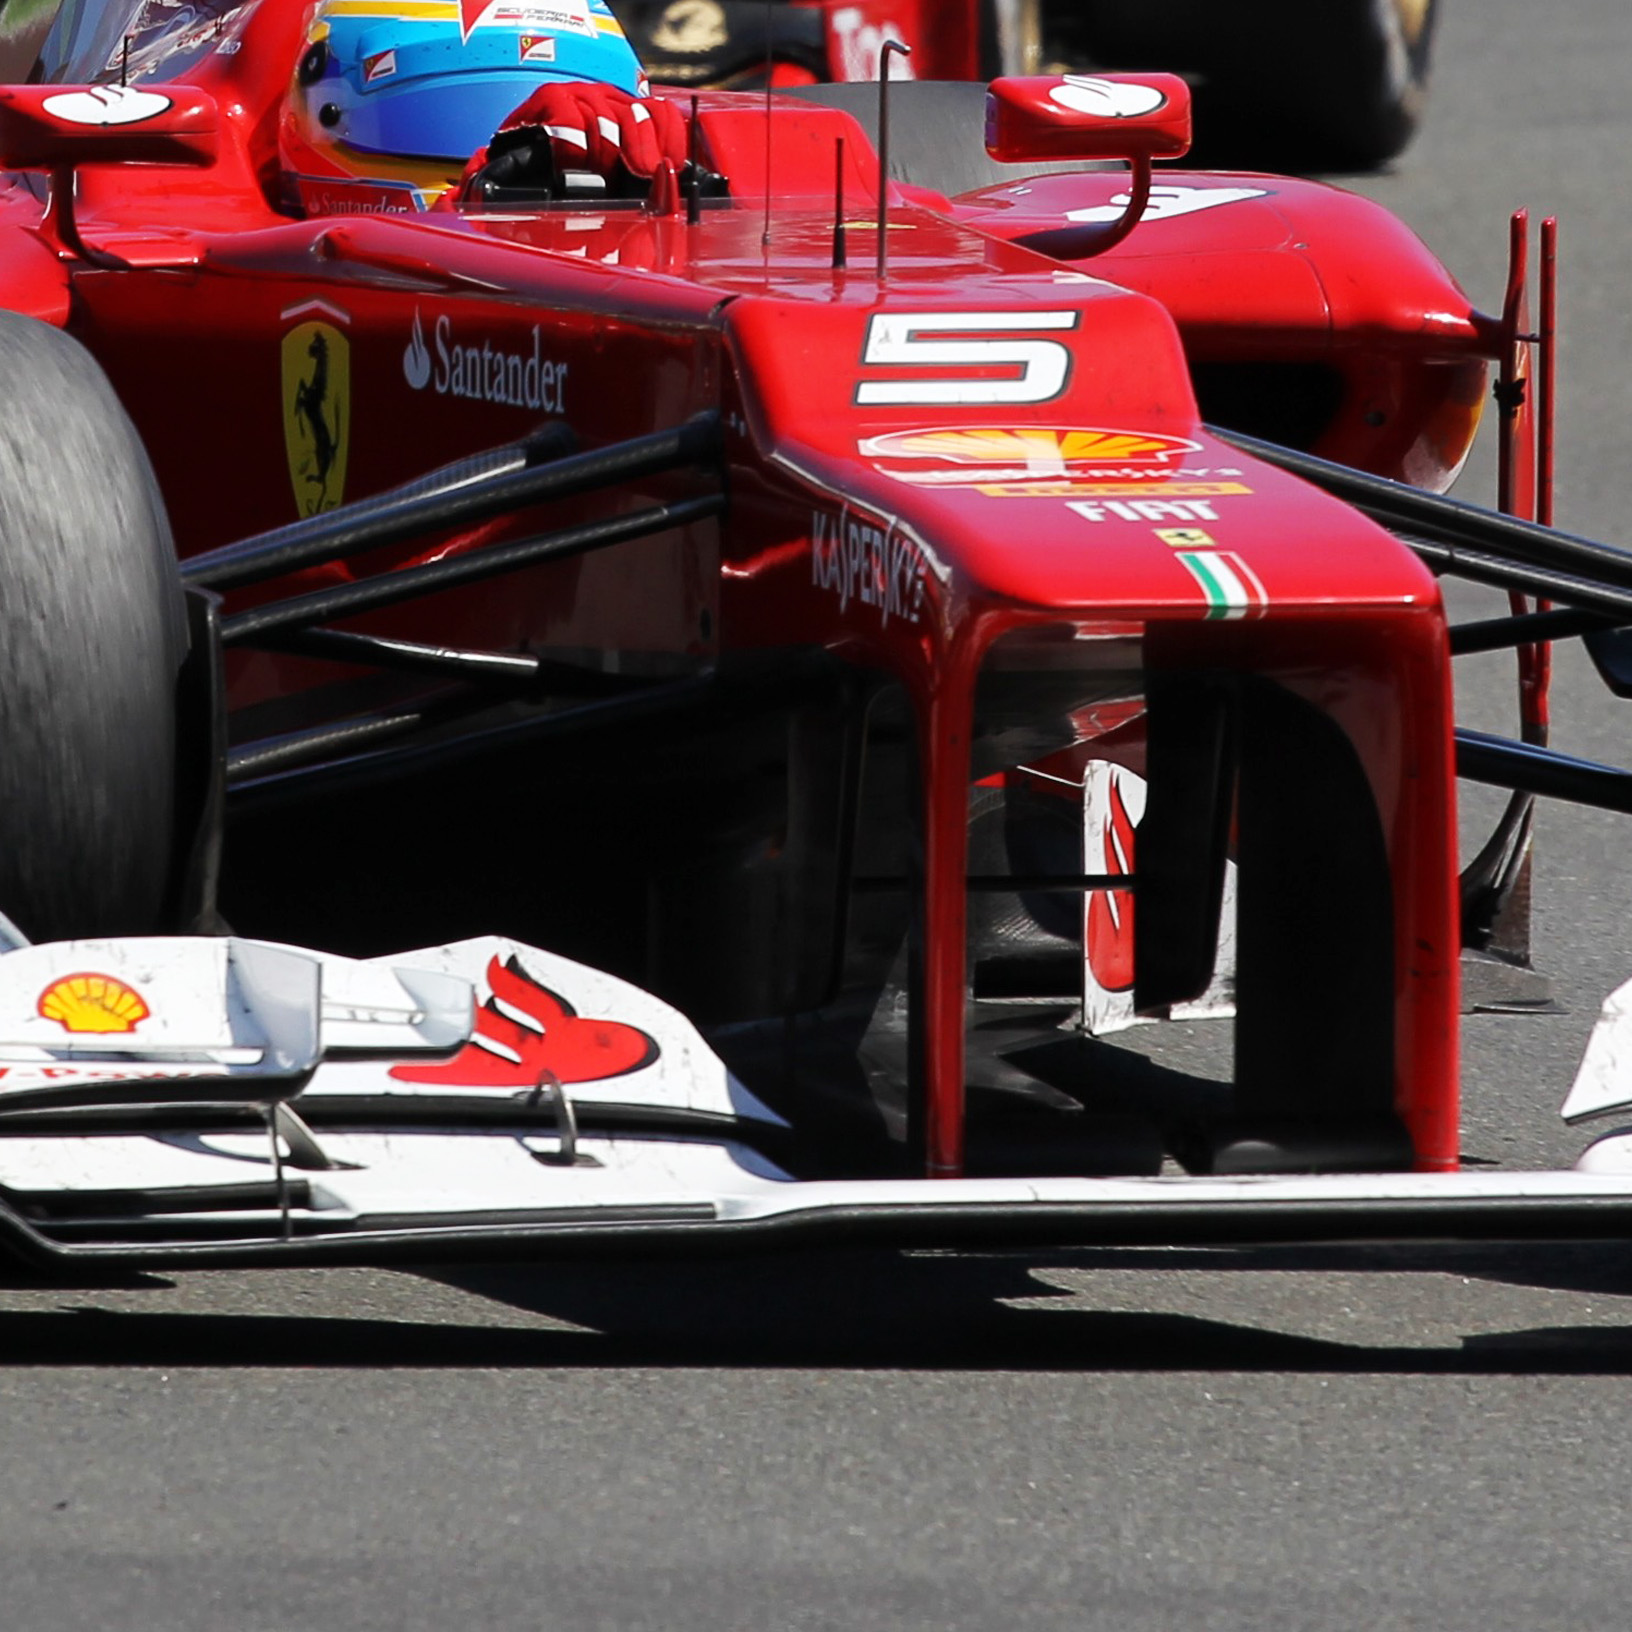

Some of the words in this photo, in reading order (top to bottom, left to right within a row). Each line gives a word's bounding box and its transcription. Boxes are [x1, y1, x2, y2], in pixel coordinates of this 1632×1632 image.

[434, 313, 568, 414] Santander
[854, 309, 1083, 407] 5
[1064, 499, 1221, 523] FIAT
